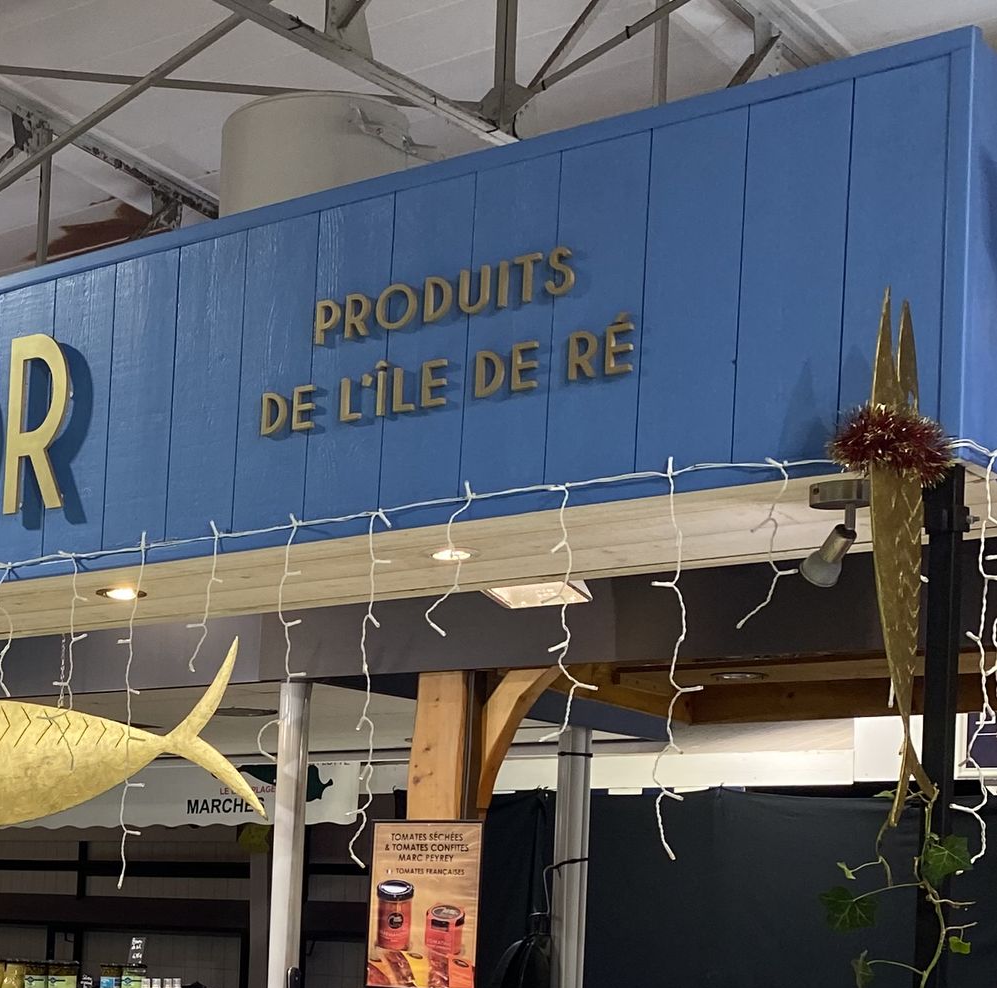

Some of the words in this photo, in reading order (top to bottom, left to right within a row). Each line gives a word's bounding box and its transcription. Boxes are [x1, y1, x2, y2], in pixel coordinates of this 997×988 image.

[314, 246, 576, 345] PRODUITS
[260, 384, 316, 436] DE
[340, 360, 449, 422] L'ÎLE
[475, 340, 540, 398] DE
[568, 312, 636, 381] RÉ
[391, 833, 427, 841] TOMATES
[429, 831, 463, 841] SÉCHÉES
[392, 844, 429, 852] TOMATES
[431, 844, 469, 852] CONFITES
[398, 854, 423, 862] MARC
[425, 854, 454, 862] PEYREY
[396, 867, 424, 875] TOMATES
[426, 868, 465, 876] FRANÇAISES
